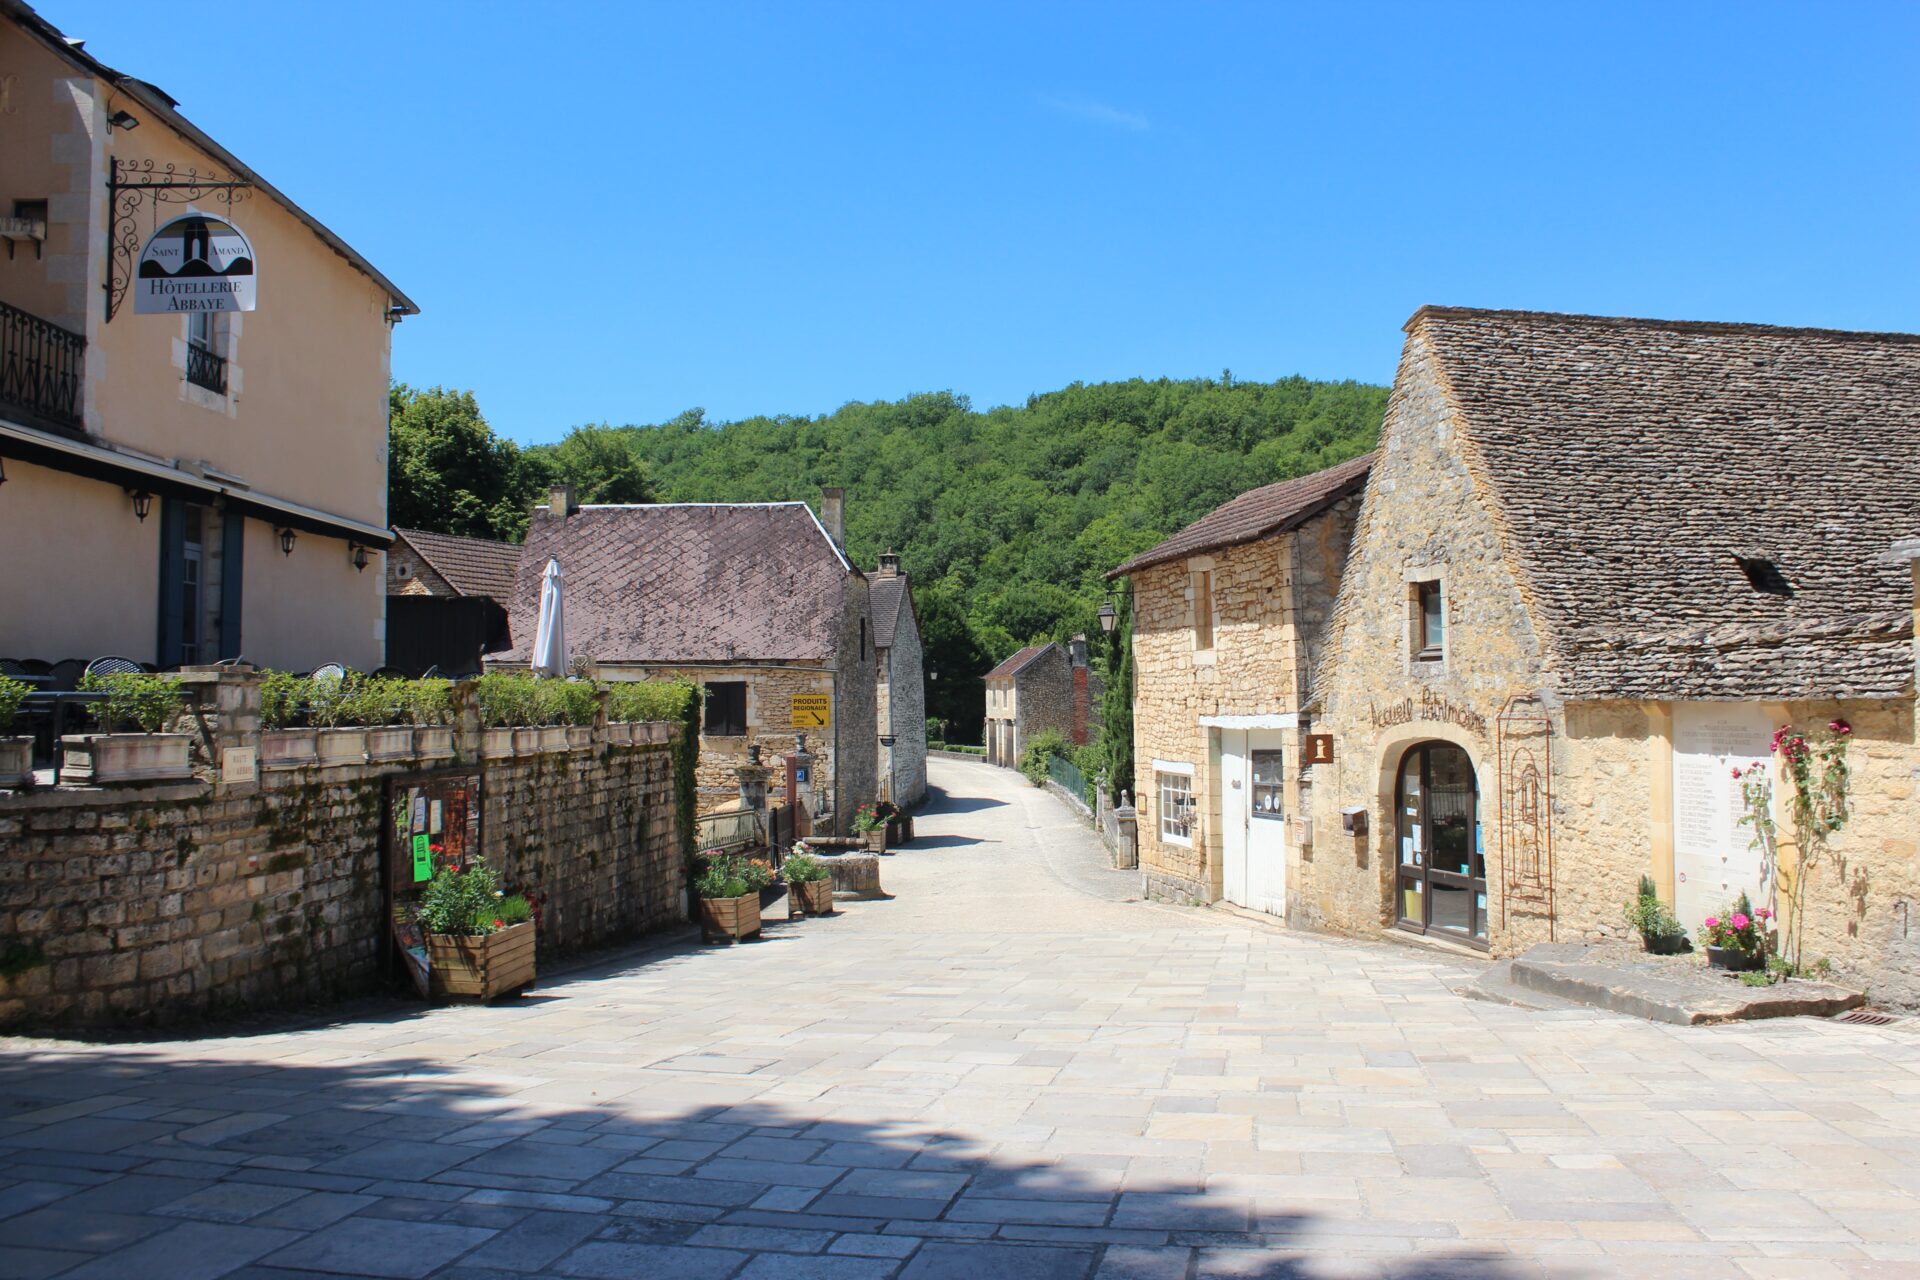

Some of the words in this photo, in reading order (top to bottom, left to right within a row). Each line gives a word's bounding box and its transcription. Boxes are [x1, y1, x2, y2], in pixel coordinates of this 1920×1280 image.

[152, 246, 180, 257] SAINT
[210, 246, 244, 256] AMAND
[167, 295, 225, 311] ABBAYE
